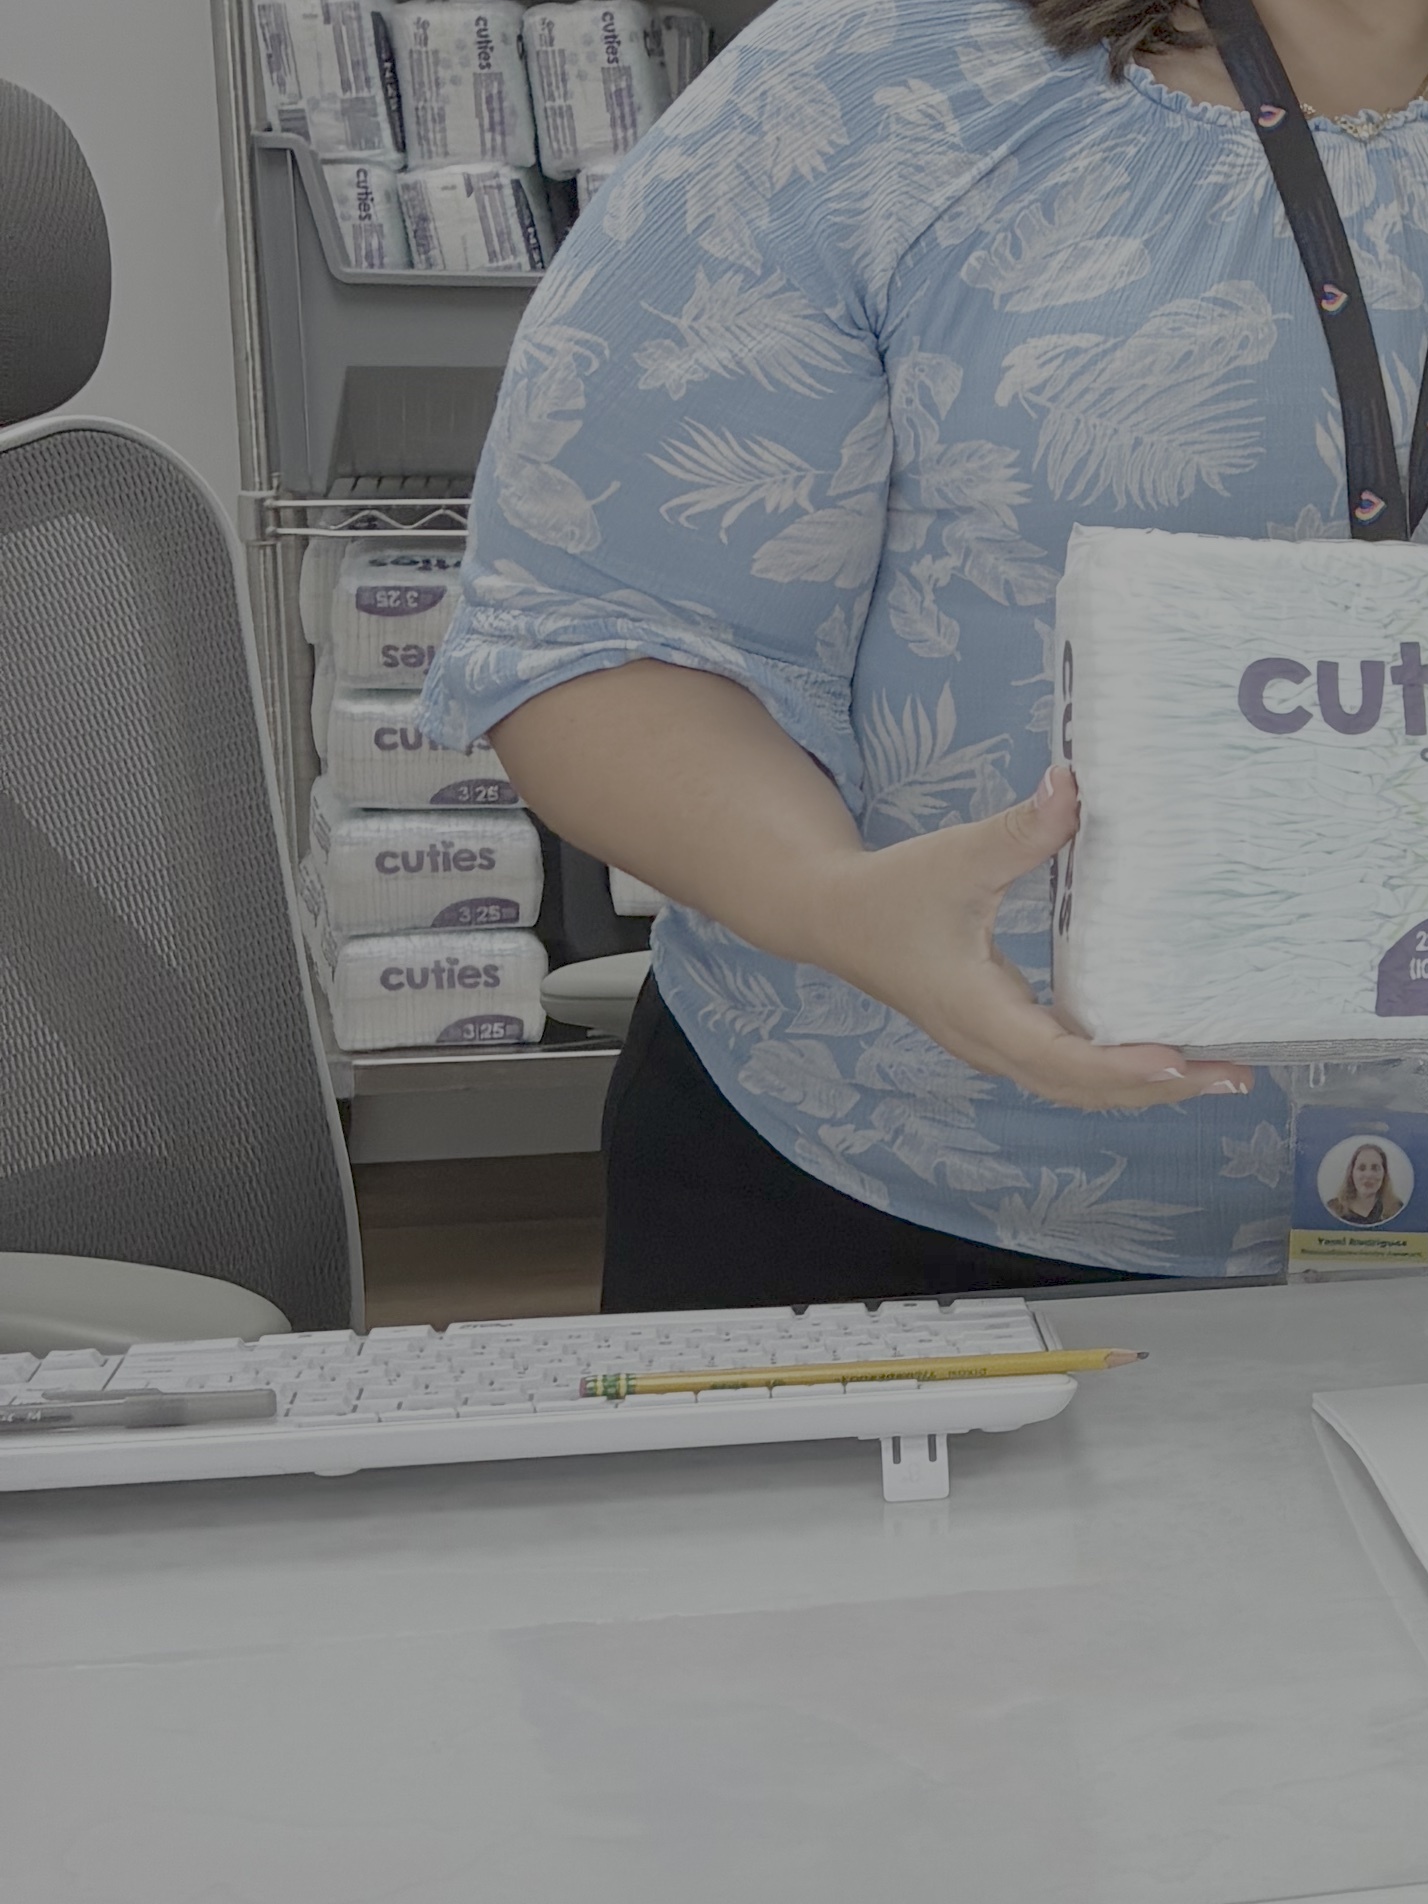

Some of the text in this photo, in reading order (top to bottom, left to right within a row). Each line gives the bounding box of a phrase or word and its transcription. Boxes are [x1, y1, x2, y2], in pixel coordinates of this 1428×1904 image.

[475, 16, 493, 72] cuties
[602, 11, 620, 65] cuties
[356, 168, 373, 222] cuties
[374, 590, 419, 608] 3 25
[459, 786, 469, 802] 3
[374, 840, 496, 875] cuties
[459, 904, 501, 923] 3 25
[380, 957, 501, 991] cuties
[462, 1020, 505, 1040] 3 25
